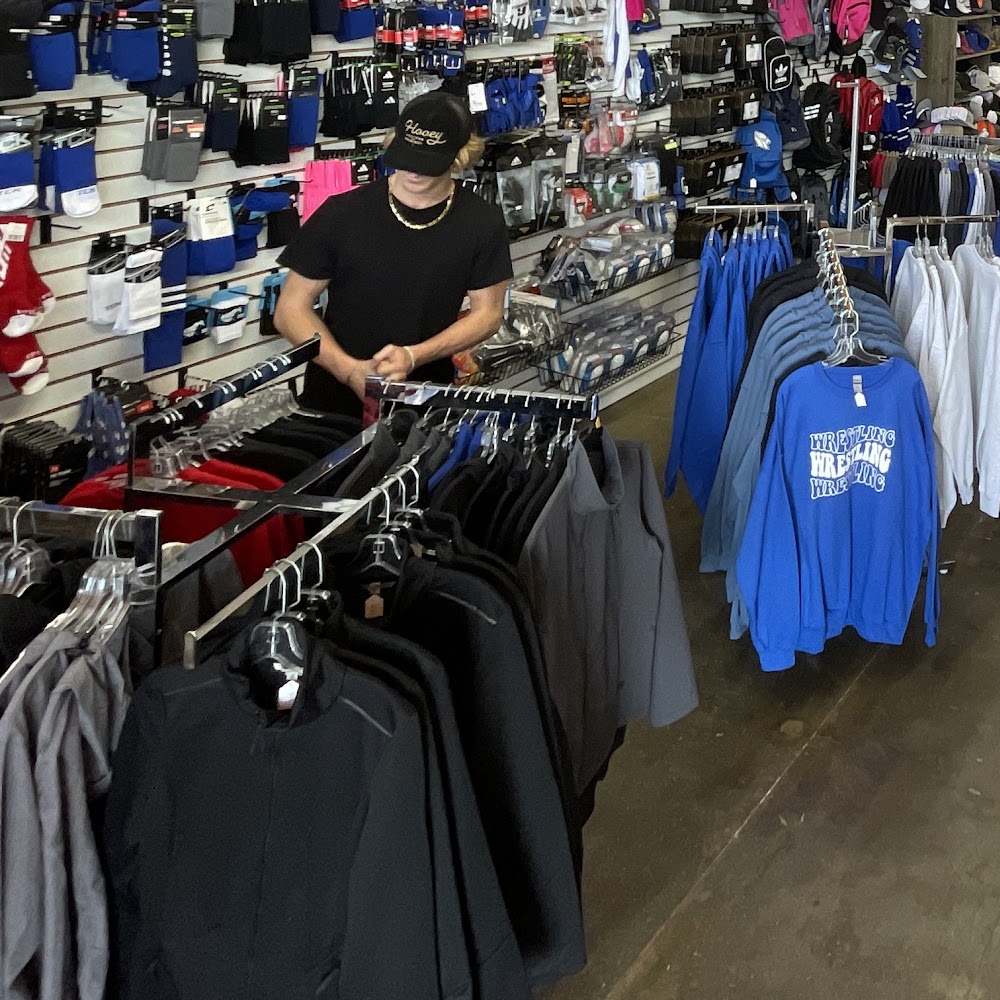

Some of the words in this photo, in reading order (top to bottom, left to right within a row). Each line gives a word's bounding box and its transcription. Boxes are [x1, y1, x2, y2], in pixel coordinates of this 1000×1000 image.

[404, 119, 447, 146] Hooey
[809, 424, 896, 454] WRESTLING
[809, 441, 892, 479] WRESTLING
